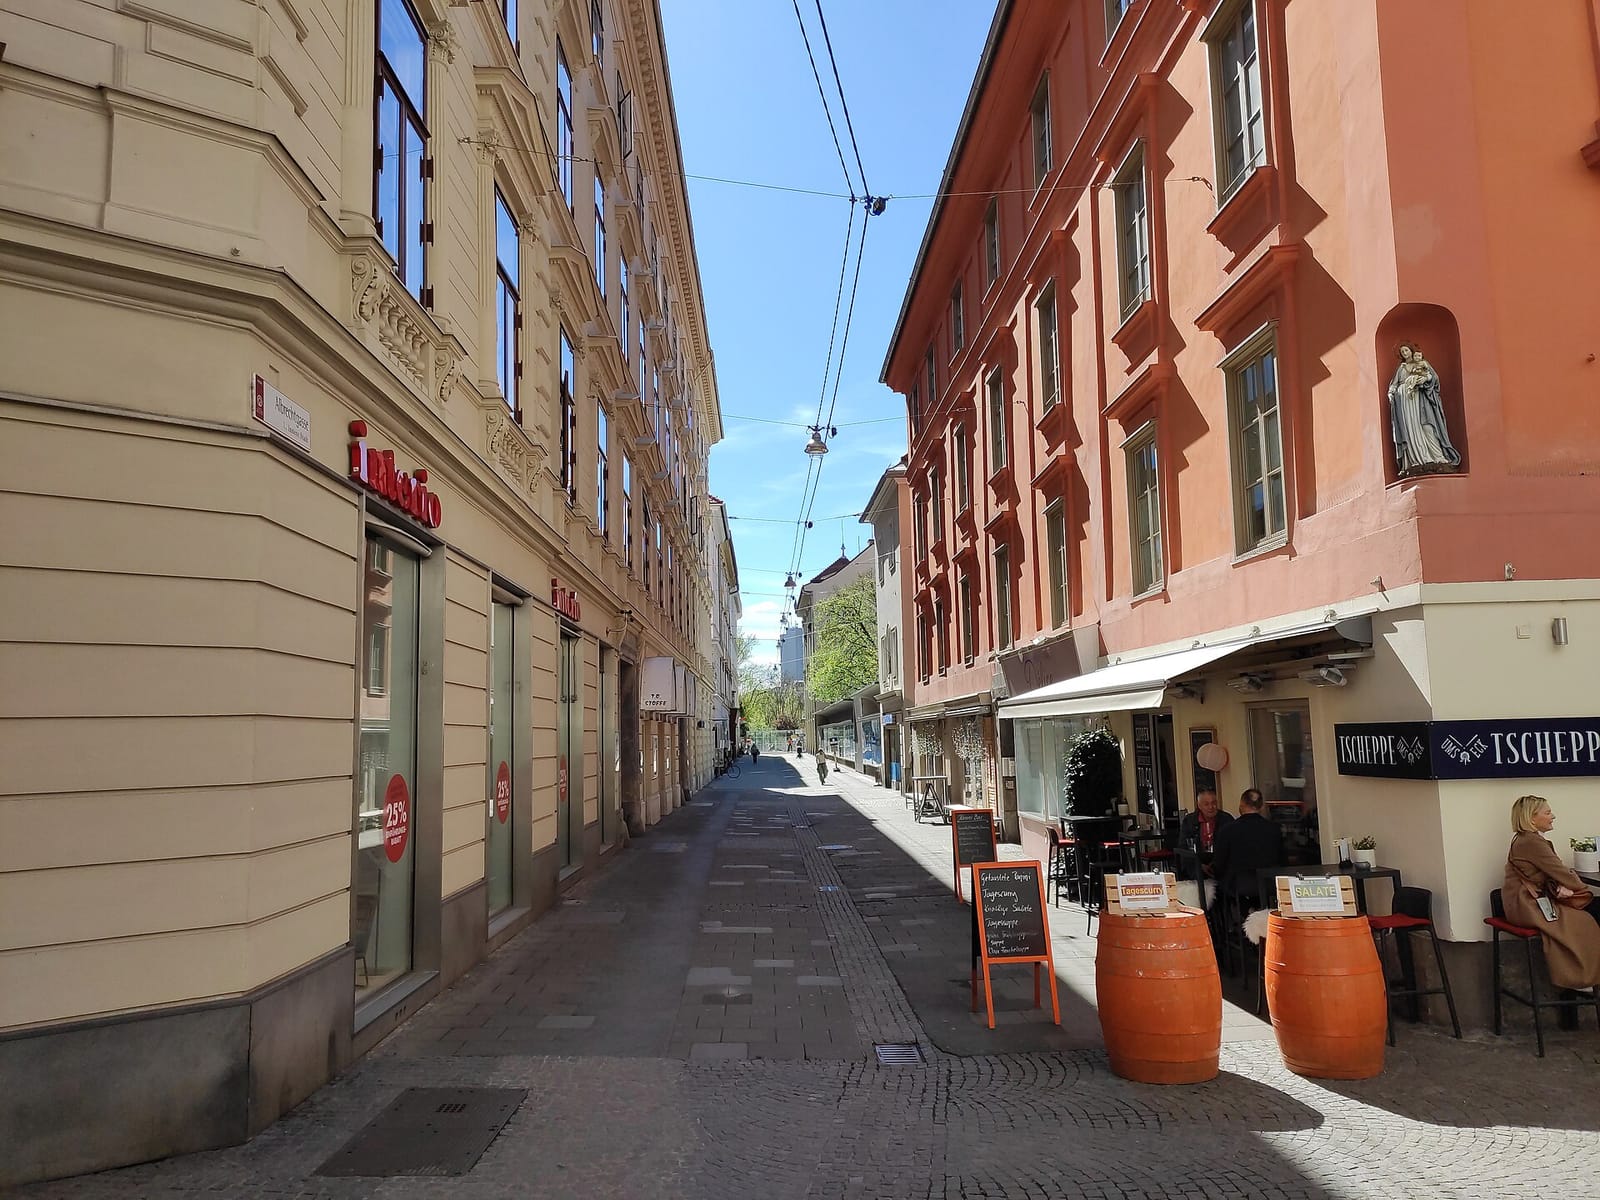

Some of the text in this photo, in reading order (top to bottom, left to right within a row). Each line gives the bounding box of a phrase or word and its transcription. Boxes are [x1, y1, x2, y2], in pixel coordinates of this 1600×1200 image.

[275, 396, 309, 432] Albrechtgasse
[1339, 735, 1397, 765] TSCHEPPE
[1440, 738, 1488, 759] UMS ECK
[497, 780, 509, 799] 25%
[386, 800, 407, 828] 25%
[1121, 887, 1163, 897] Tagescurry
[1295, 886, 1336, 897] SALATE
